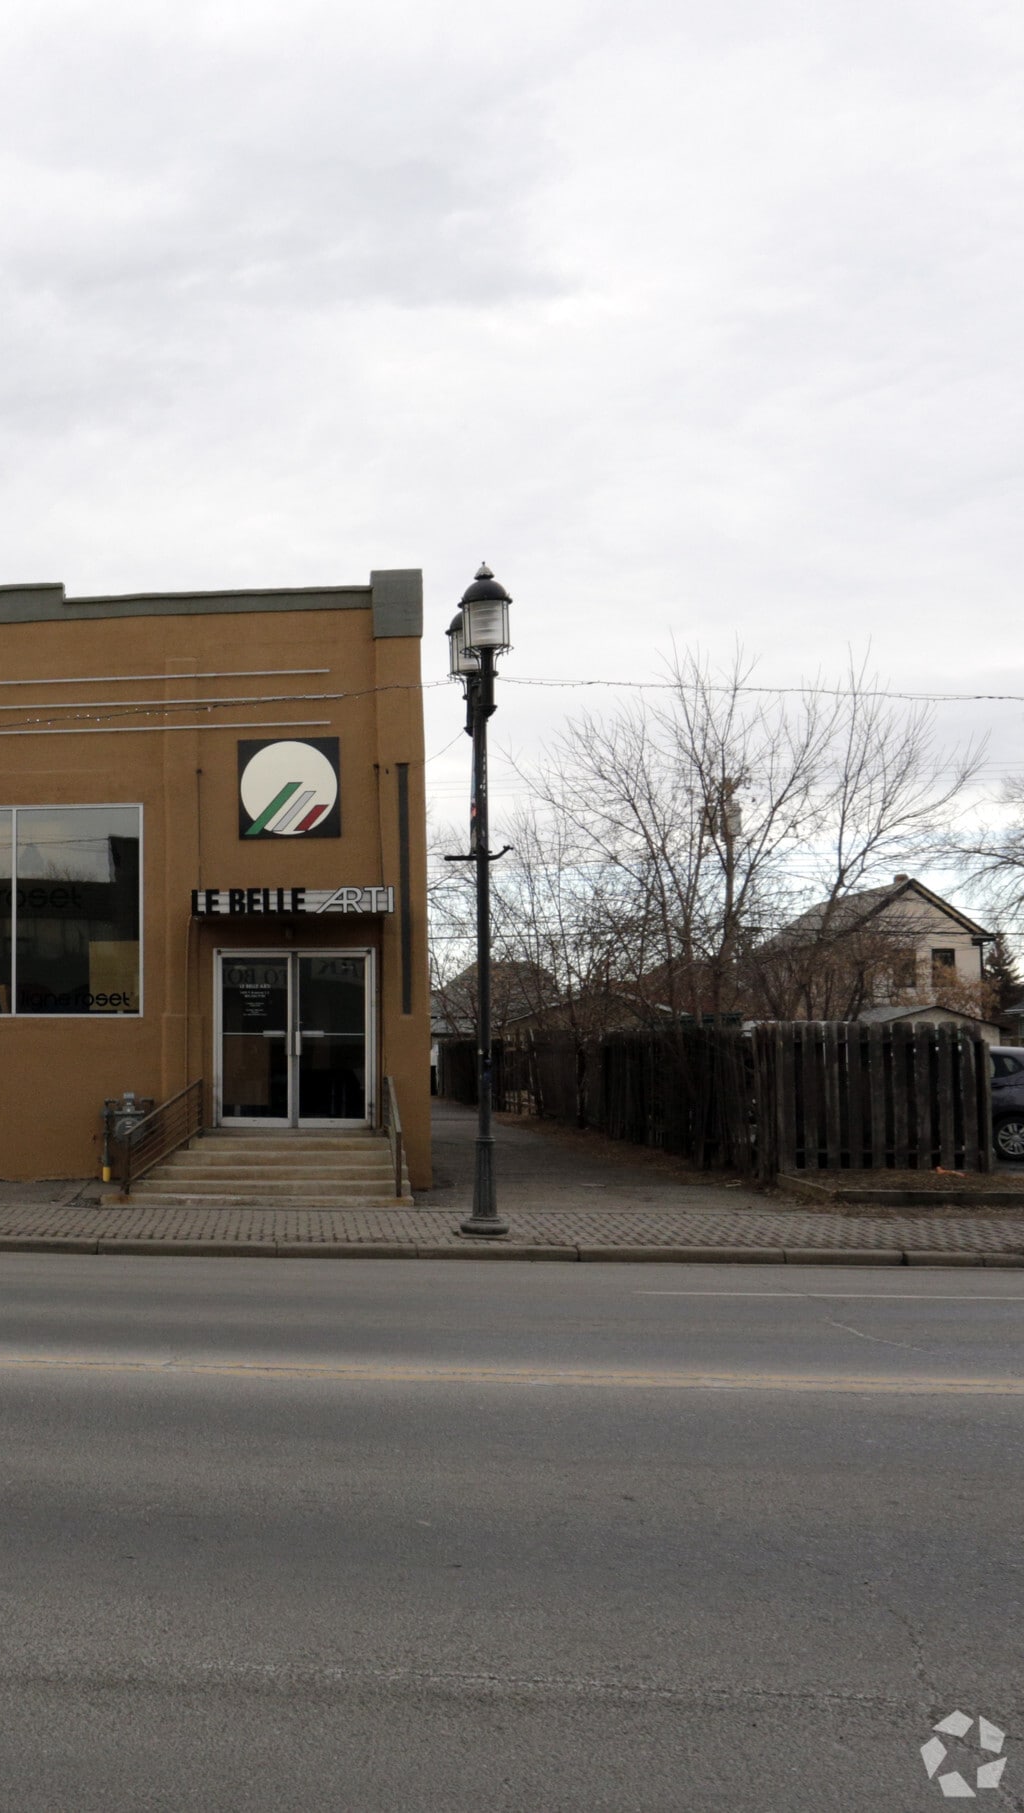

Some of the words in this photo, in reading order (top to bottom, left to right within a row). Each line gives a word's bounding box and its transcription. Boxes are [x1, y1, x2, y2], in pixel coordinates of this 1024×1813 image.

[191, 889, 220, 915] LE
[229, 887, 306, 914] BELLE
[316, 886, 394, 914] ARTI
[74, 991, 130, 1007] roset
